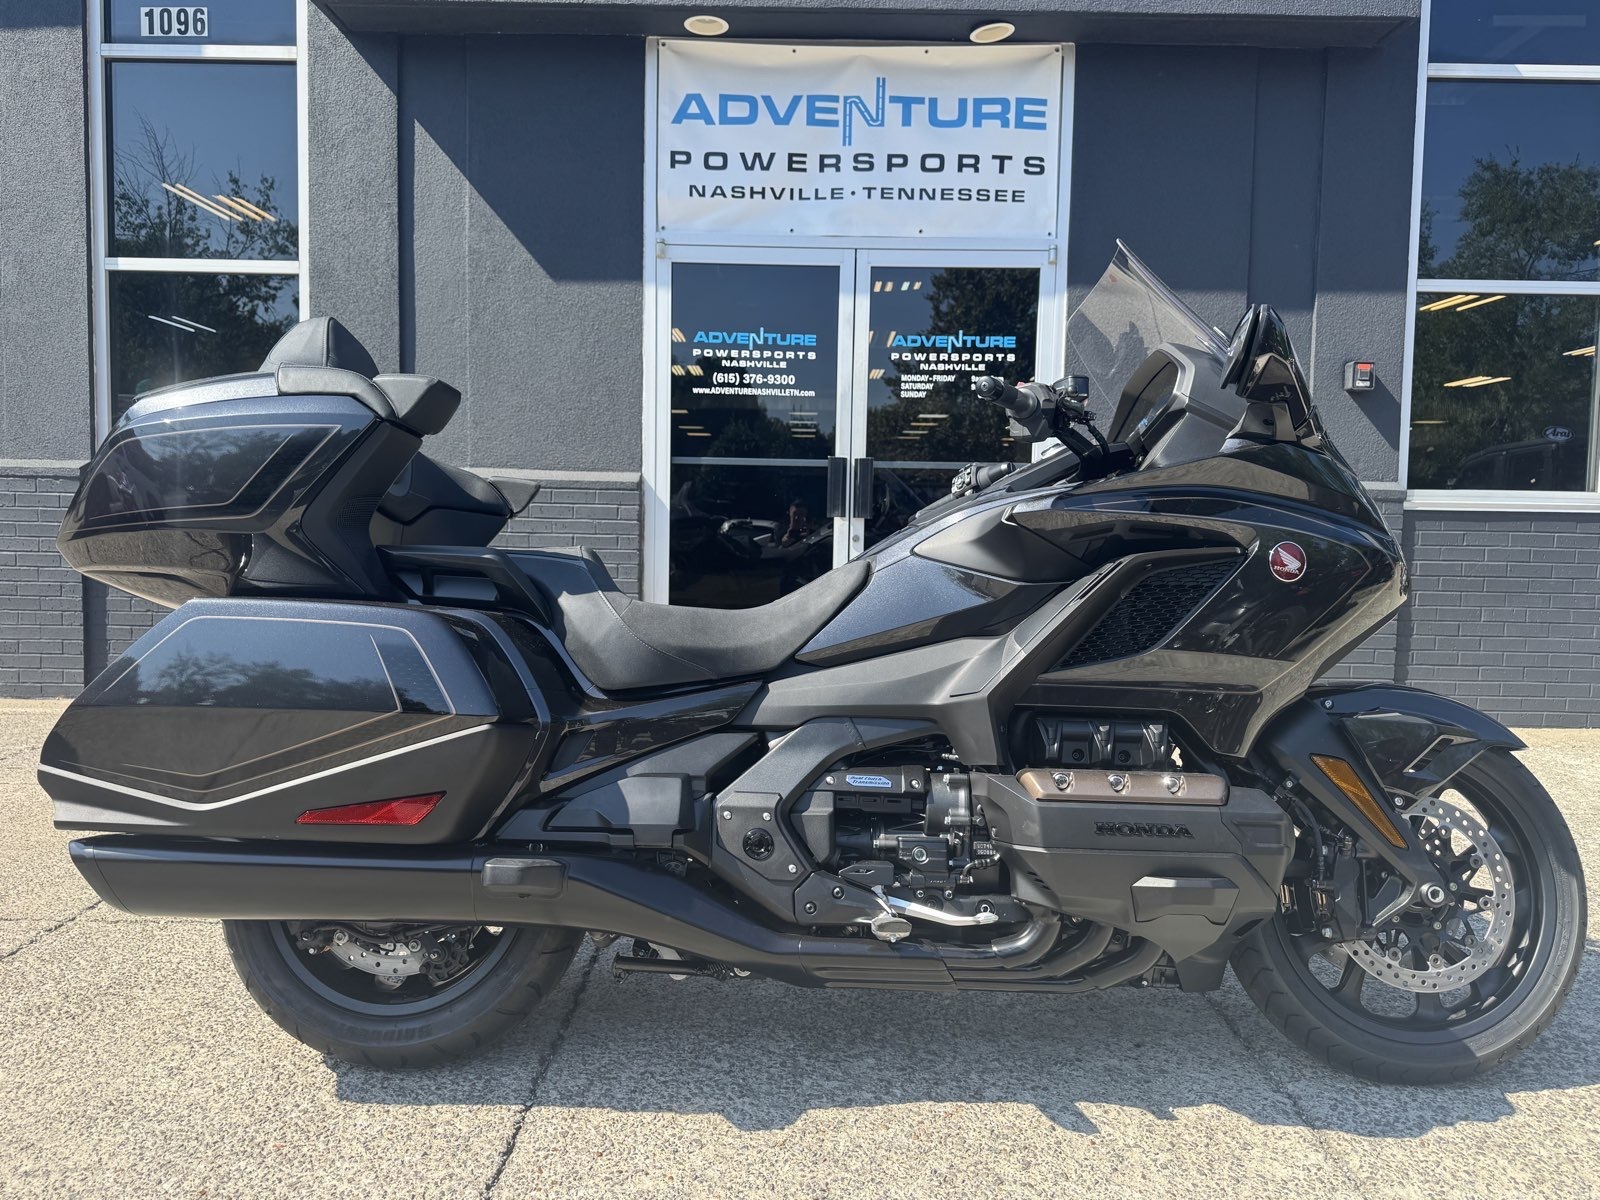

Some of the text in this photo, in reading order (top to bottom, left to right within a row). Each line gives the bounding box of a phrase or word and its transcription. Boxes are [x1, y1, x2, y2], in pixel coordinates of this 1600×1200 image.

[144, 7, 206, 36] 1096
[671, 77, 1048, 146] ADVENTURE
[669, 150, 1046, 176] POWERSPORTS
[693, 327, 817, 350] ADVENTURE
[892, 330, 1017, 353] ADVENTURE
[692, 348, 817, 360] POWERSPORTS
[890, 352, 1016, 362] POWERSPORTS
[721, 359, 787, 368] NASHVILLE
[919, 363, 986, 371] NASHVILLE
[712, 372, 796, 385] (615) 376-9300
[692, 386, 816, 397] www.ADVENTURENASHVILLETN.com
[1273, 565, 1300, 575] HONDA
[1093, 821, 1196, 838] HONDA
